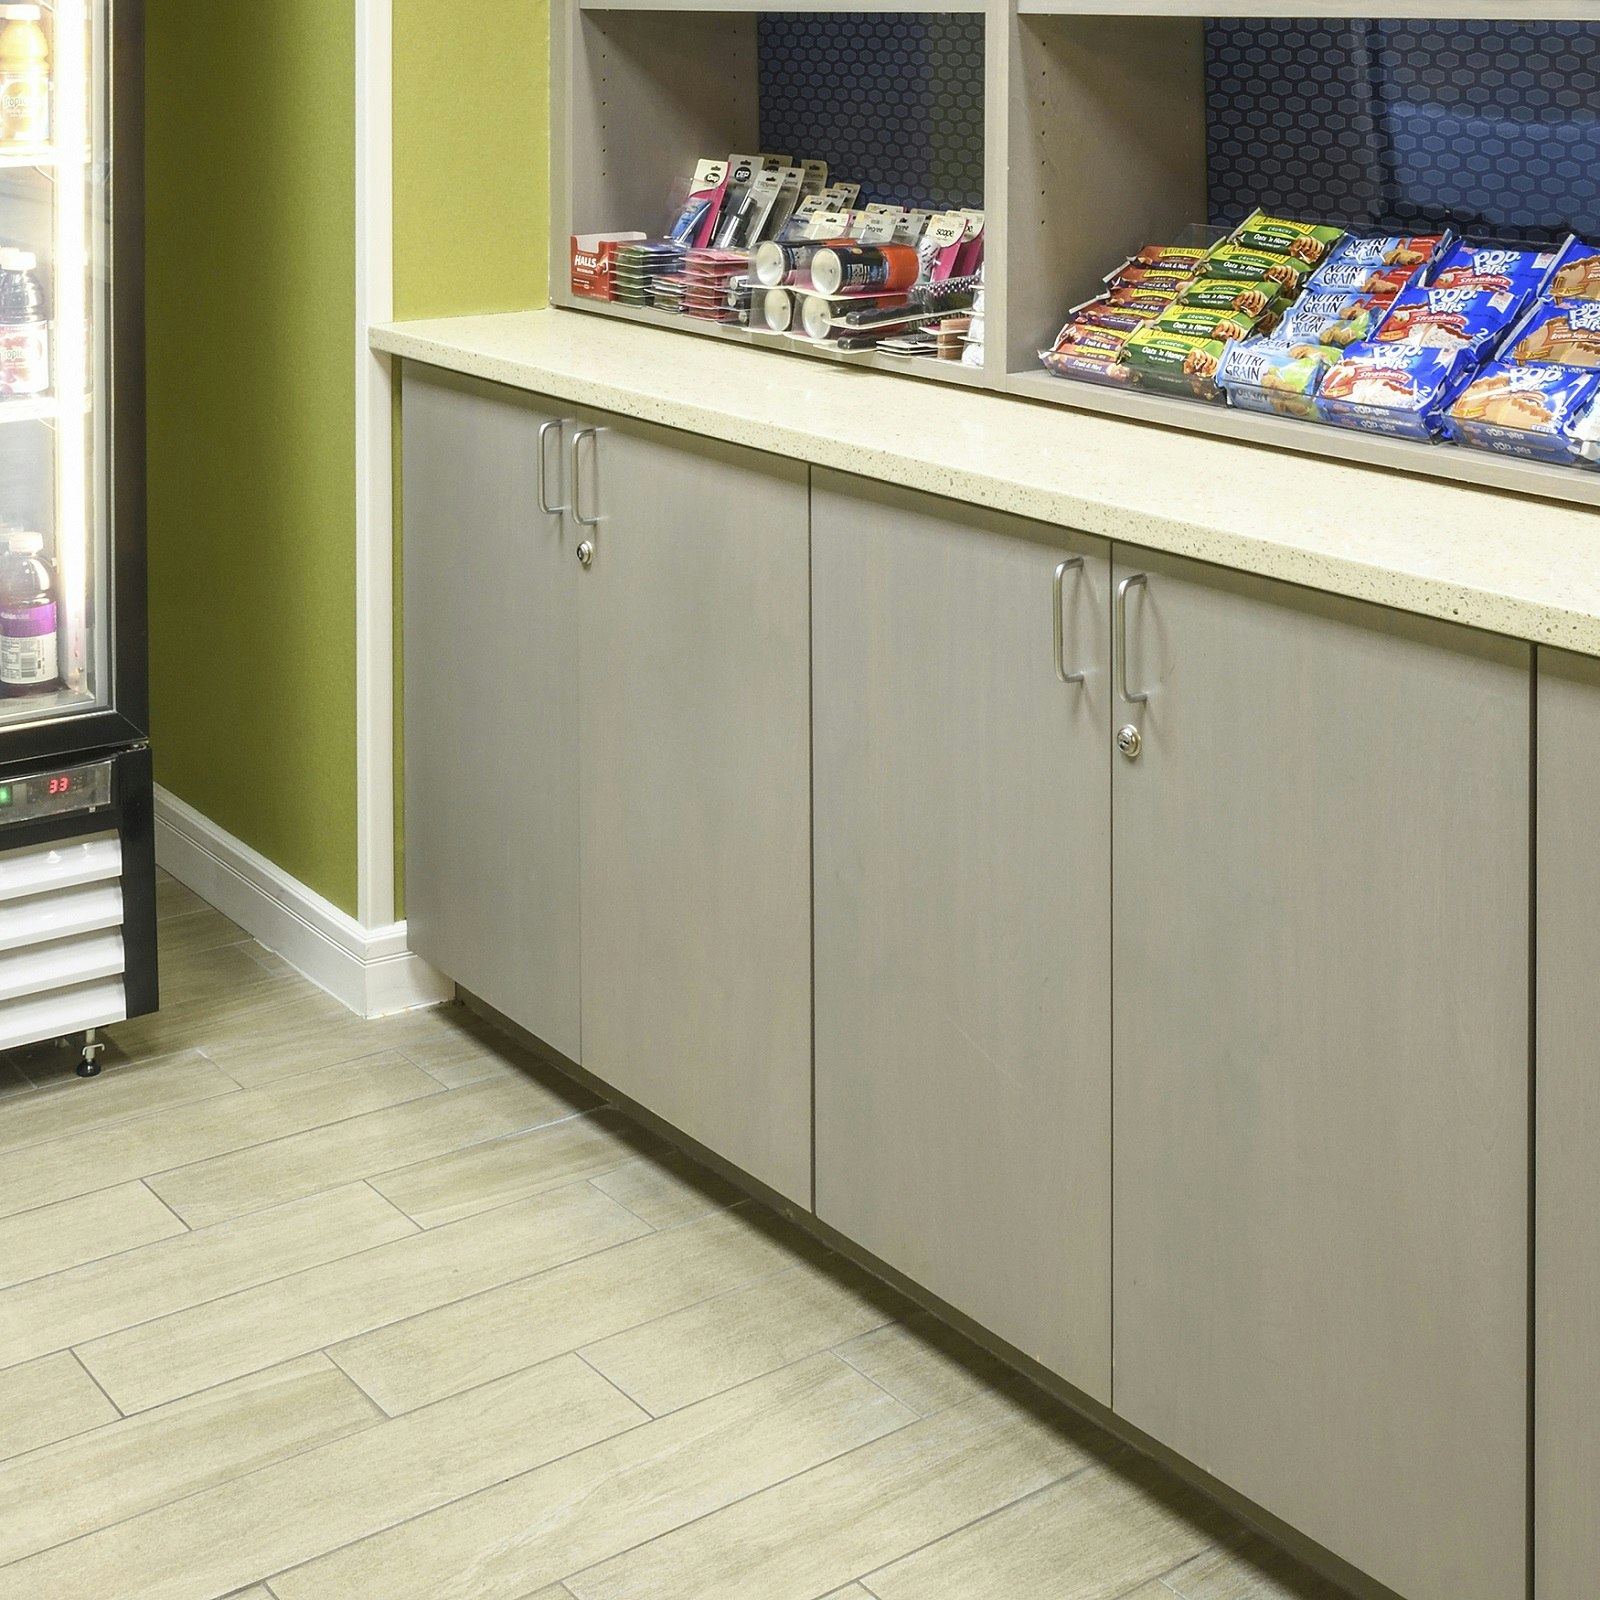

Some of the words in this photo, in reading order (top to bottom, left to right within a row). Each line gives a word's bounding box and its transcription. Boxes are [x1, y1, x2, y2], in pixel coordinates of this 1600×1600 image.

[735, 169, 750, 180] DEP
[935, 228, 955, 238] scope
[1253, 233, 1268, 241] Oats
[1274, 237, 1292, 246] Honey
[574, 254, 597, 269] HALLS
[1458, 275, 1508, 286] Strawberry
[1414, 314, 1462, 324] Strawberry
[1477, 327, 1489, 339] 2
[1141, 346, 1156, 355] Oats
[1165, 351, 1186, 362] Honey
[1073, 359, 1087, 368] Fruit
[1090, 363, 1103, 371] Nut
[1224, 364, 1261, 382] GRAIN
[48, 776, 70, 795] 33
